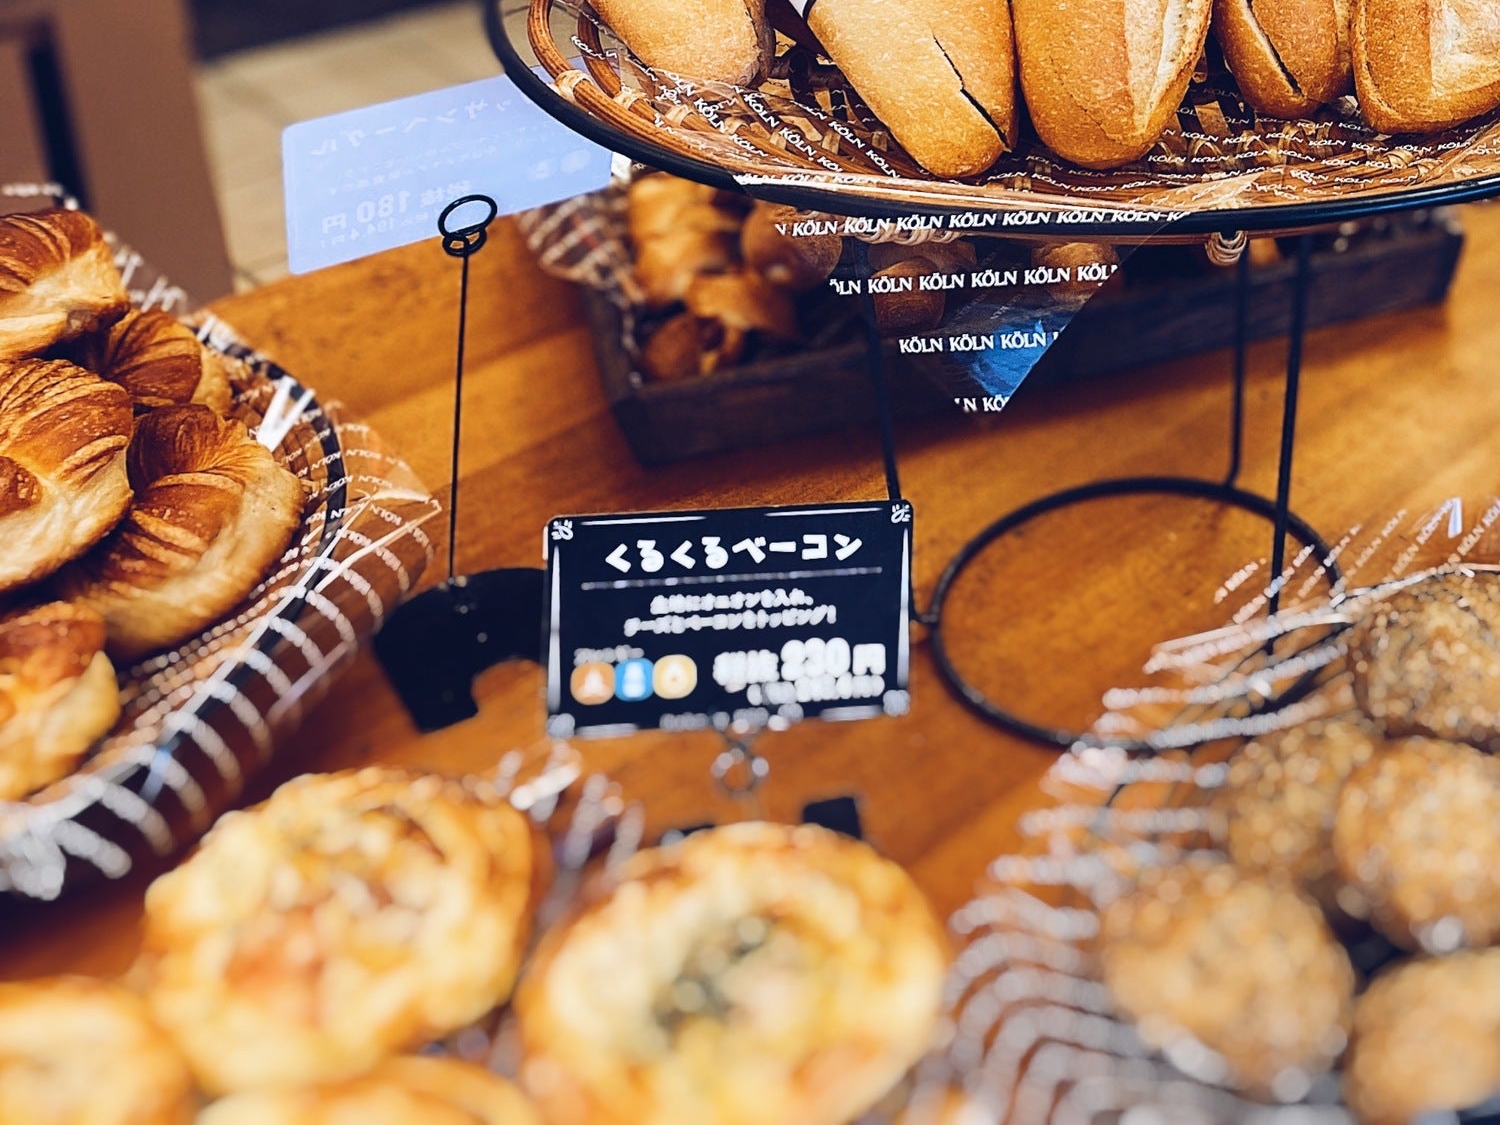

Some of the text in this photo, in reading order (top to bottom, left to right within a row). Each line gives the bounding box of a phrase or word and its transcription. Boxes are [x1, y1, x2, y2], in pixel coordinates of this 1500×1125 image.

[829, 121, 900, 178] KÖLN KÖLN
[792, 221, 838, 236] KÖLN
[844, 218, 891, 234] KÖLN
[896, 215, 943, 231] KÖLN
[949, 213, 997, 227] KÖLN
[1002, 212, 1052, 225] KÖLN
[1056, 210, 1106, 223] KÖLN
[868, 264, 1118, 293] KÖLN KÖLN KÖLN KÖLN KÖL
[899, 331, 1046, 353] KÖLN KÖLN KÖLN
[605, 532, 862, 573] くるくるベーコン
